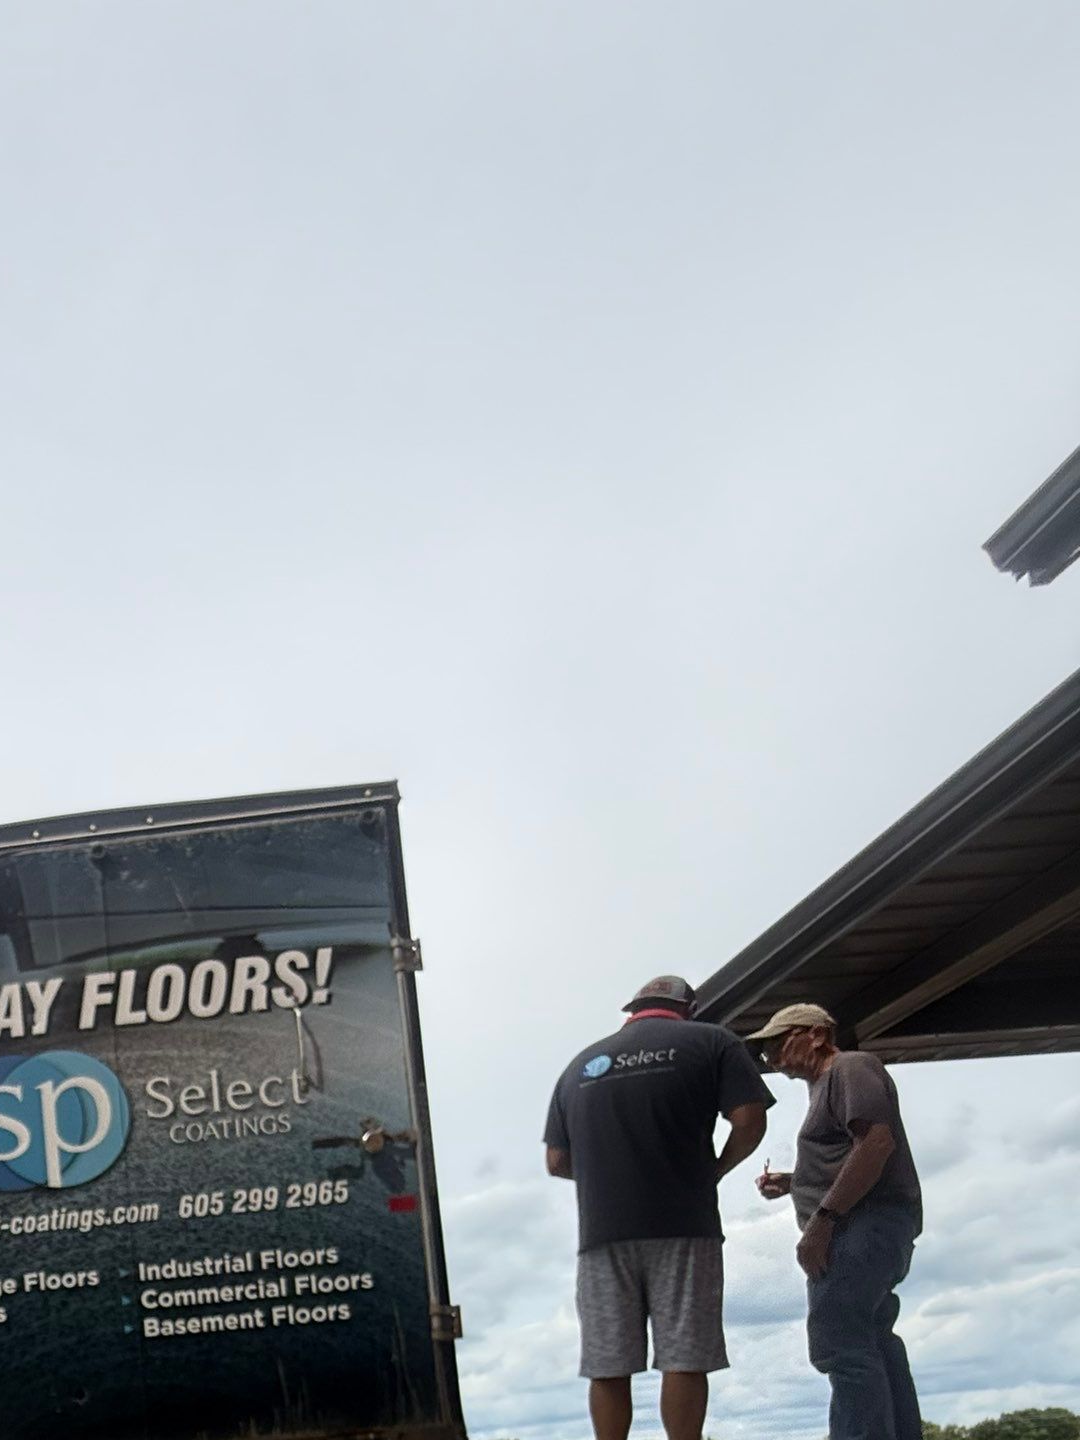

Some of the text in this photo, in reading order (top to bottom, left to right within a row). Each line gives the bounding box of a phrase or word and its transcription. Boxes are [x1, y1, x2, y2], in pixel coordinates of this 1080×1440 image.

[78, 947, 333, 1031] FLOORS!
[614, 1047, 677, 1069] Select
[145, 1068, 311, 1119] Select
[169, 1113, 292, 1144] COATINGS
[178, 1193, 224, 1219] 605
[232, 1186, 279, 1214] 299
[285, 1180, 349, 1208] 2965
[23, 1270, 100, 1292] Floors
[138, 1247, 340, 1281] Industrial Floors
[140, 1272, 374, 1309] Commercial Floors
[143, 1303, 351, 1338] Basement Floors
